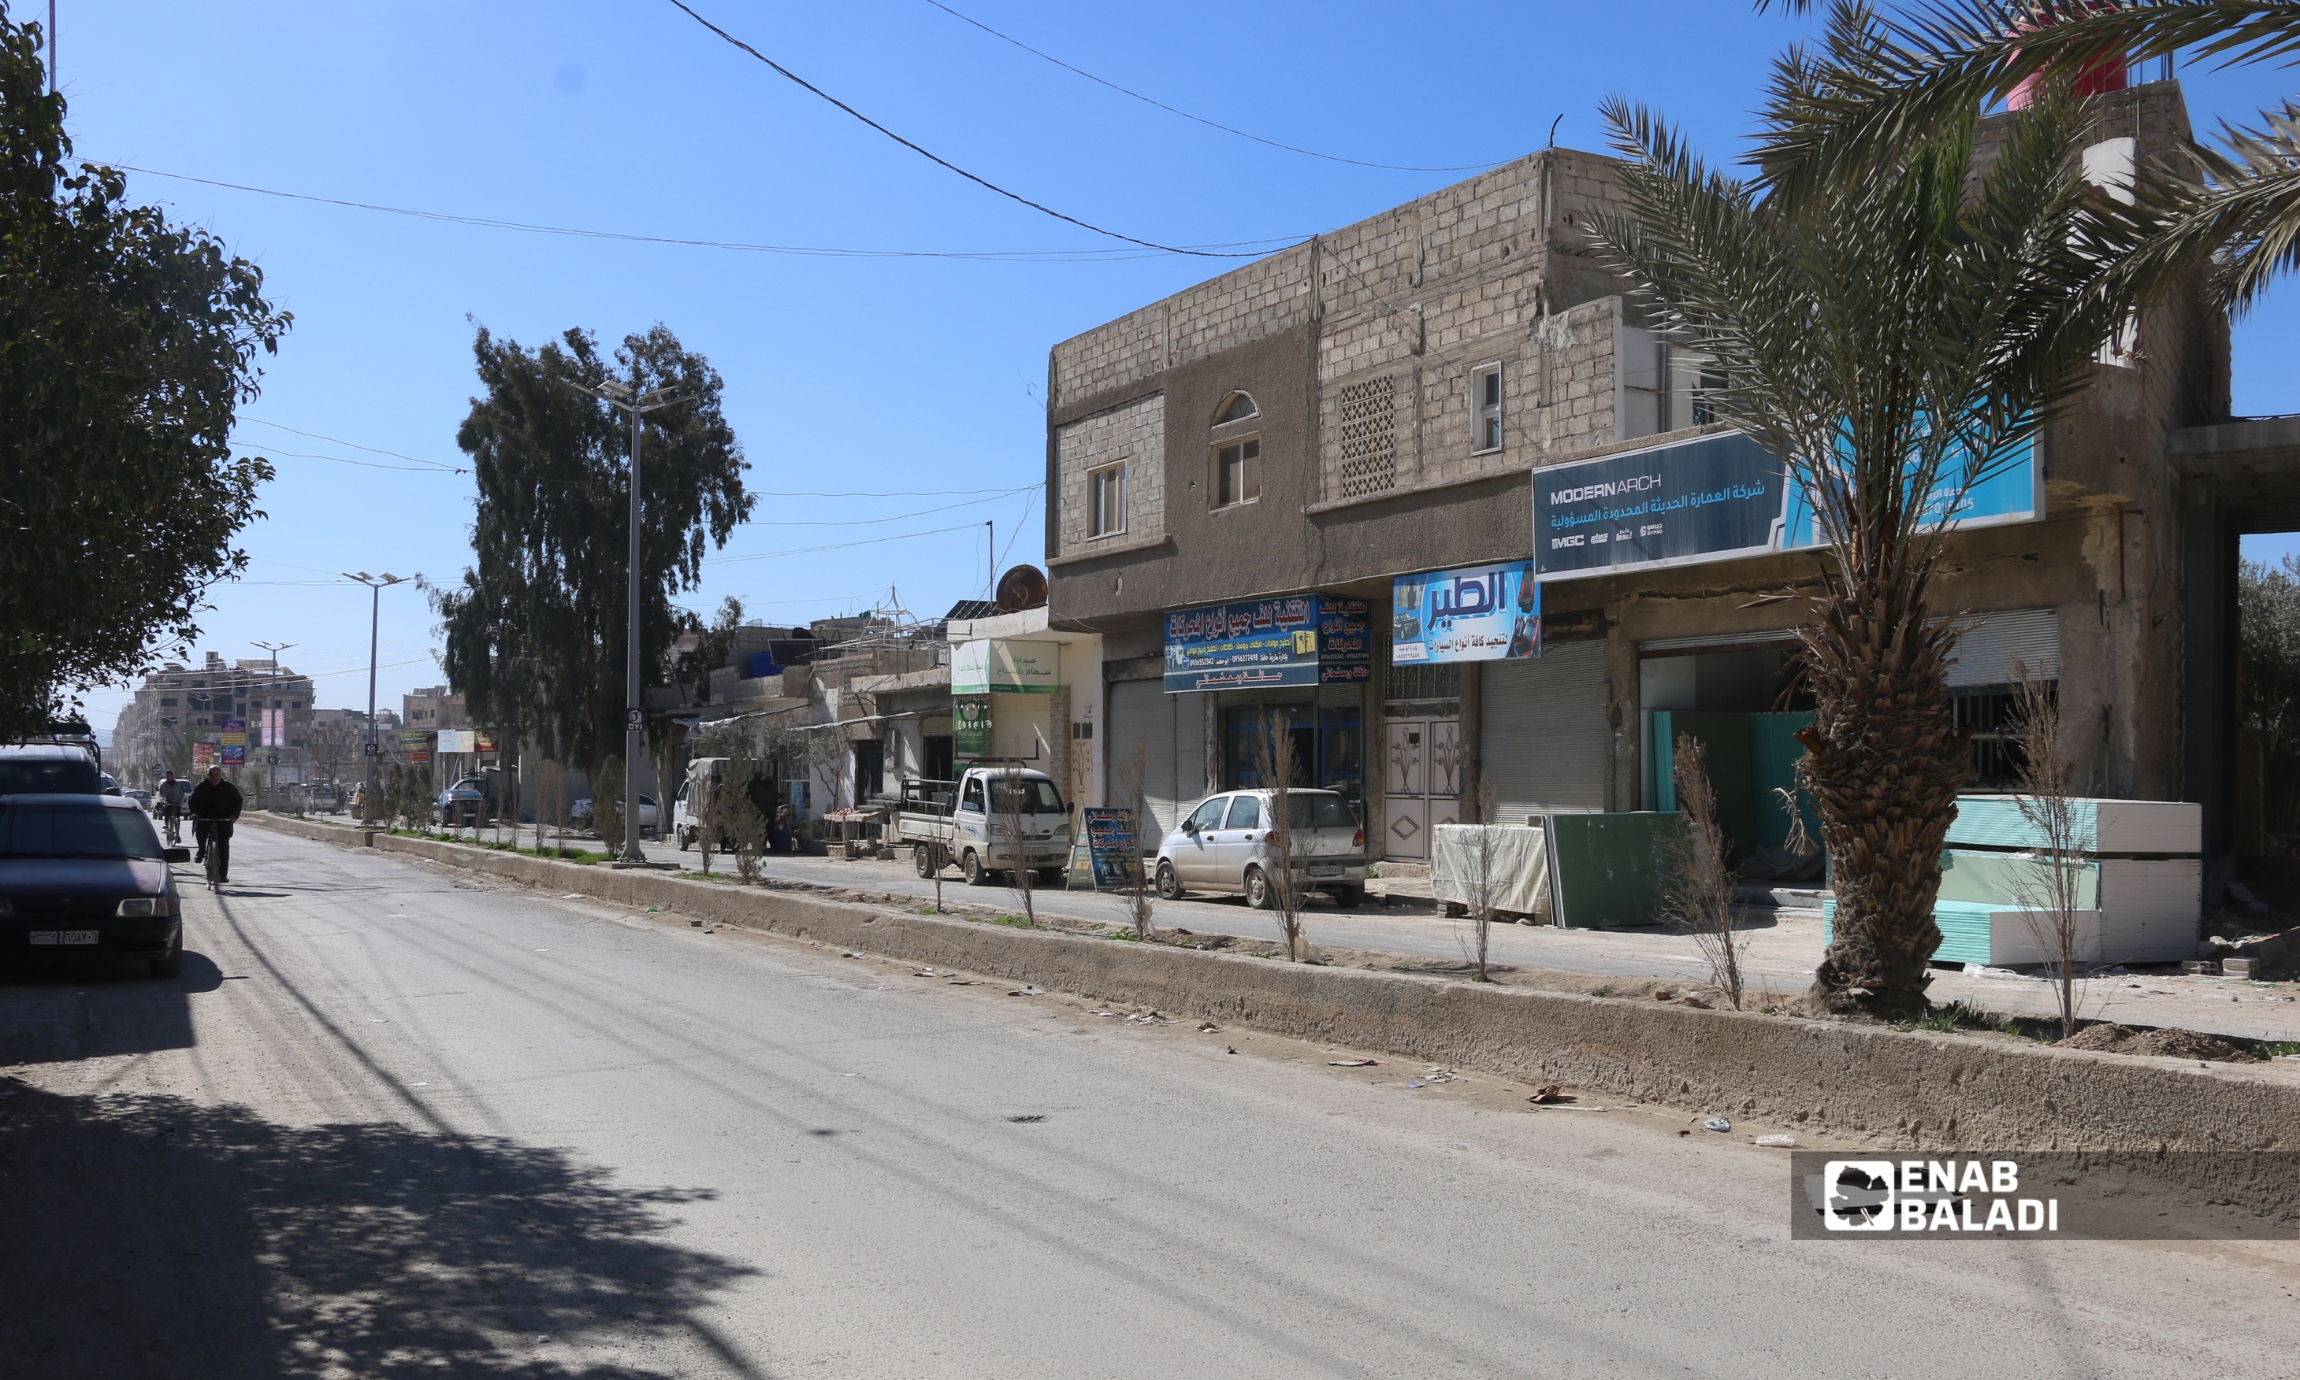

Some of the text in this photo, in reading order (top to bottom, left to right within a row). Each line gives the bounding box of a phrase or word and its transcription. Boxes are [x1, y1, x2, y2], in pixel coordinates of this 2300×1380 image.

[1551, 478, 1765, 529] شركة العمارة الحديثة المحدودة المسؤولية
[1319, 601, 1367, 616] التقنية للف
[1427, 571, 1507, 632] الطير
[1170, 600, 1310, 641] التقنية للف جميع أنواع المحركات
[1323, 618, 1365, 635] جميع أنواع
[1328, 637, 1362, 652] المحركات
[1429, 633, 1508, 653] لتنجيد كافة أنواع السيارات
[1013, 655, 1036, 666] صيدلية
[1026, 667, 1052, 677] سهام
[1091, 827, 1115, 837] جميع
[1092, 837, 1119, 851] المحركات
